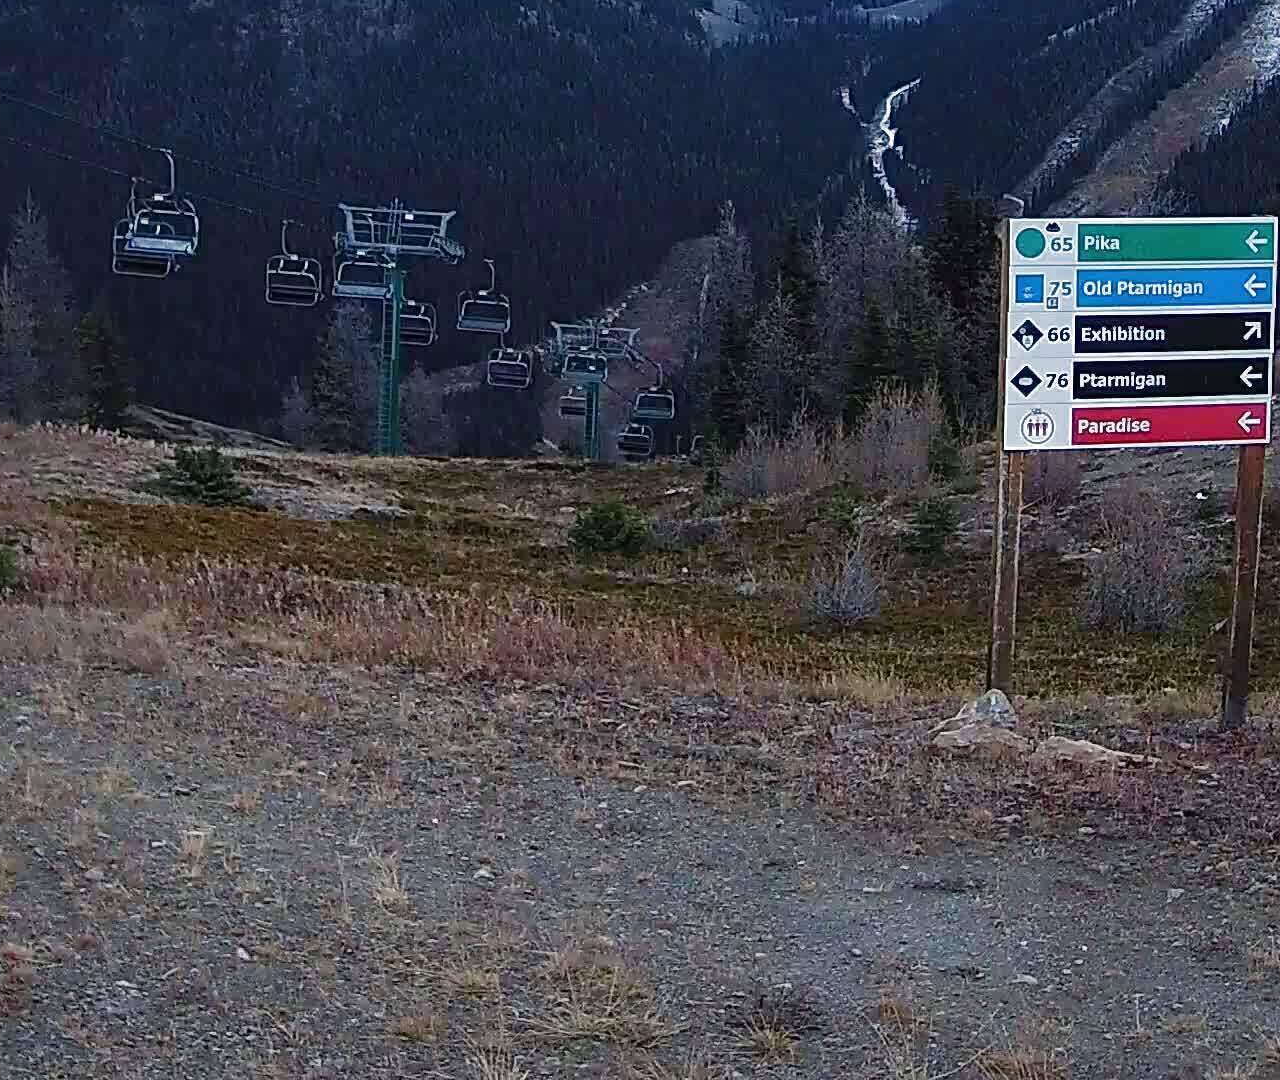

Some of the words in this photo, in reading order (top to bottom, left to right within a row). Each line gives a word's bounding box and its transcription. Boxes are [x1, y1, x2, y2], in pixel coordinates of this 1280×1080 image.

[1051, 237, 1073, 251] 65
[1084, 235, 1120, 250] Pika
[1049, 281, 1072, 296] 75
[1083, 281, 1112, 295] Old
[1117, 280, 1203, 297] Ptarmigan
[1047, 327, 1070, 342] 66
[1081, 325, 1165, 342] Exhibition
[1046, 373, 1069, 388] 76
[1079, 371, 1166, 390] Ptarmigan
[1078, 418, 1150, 434] Paradise
